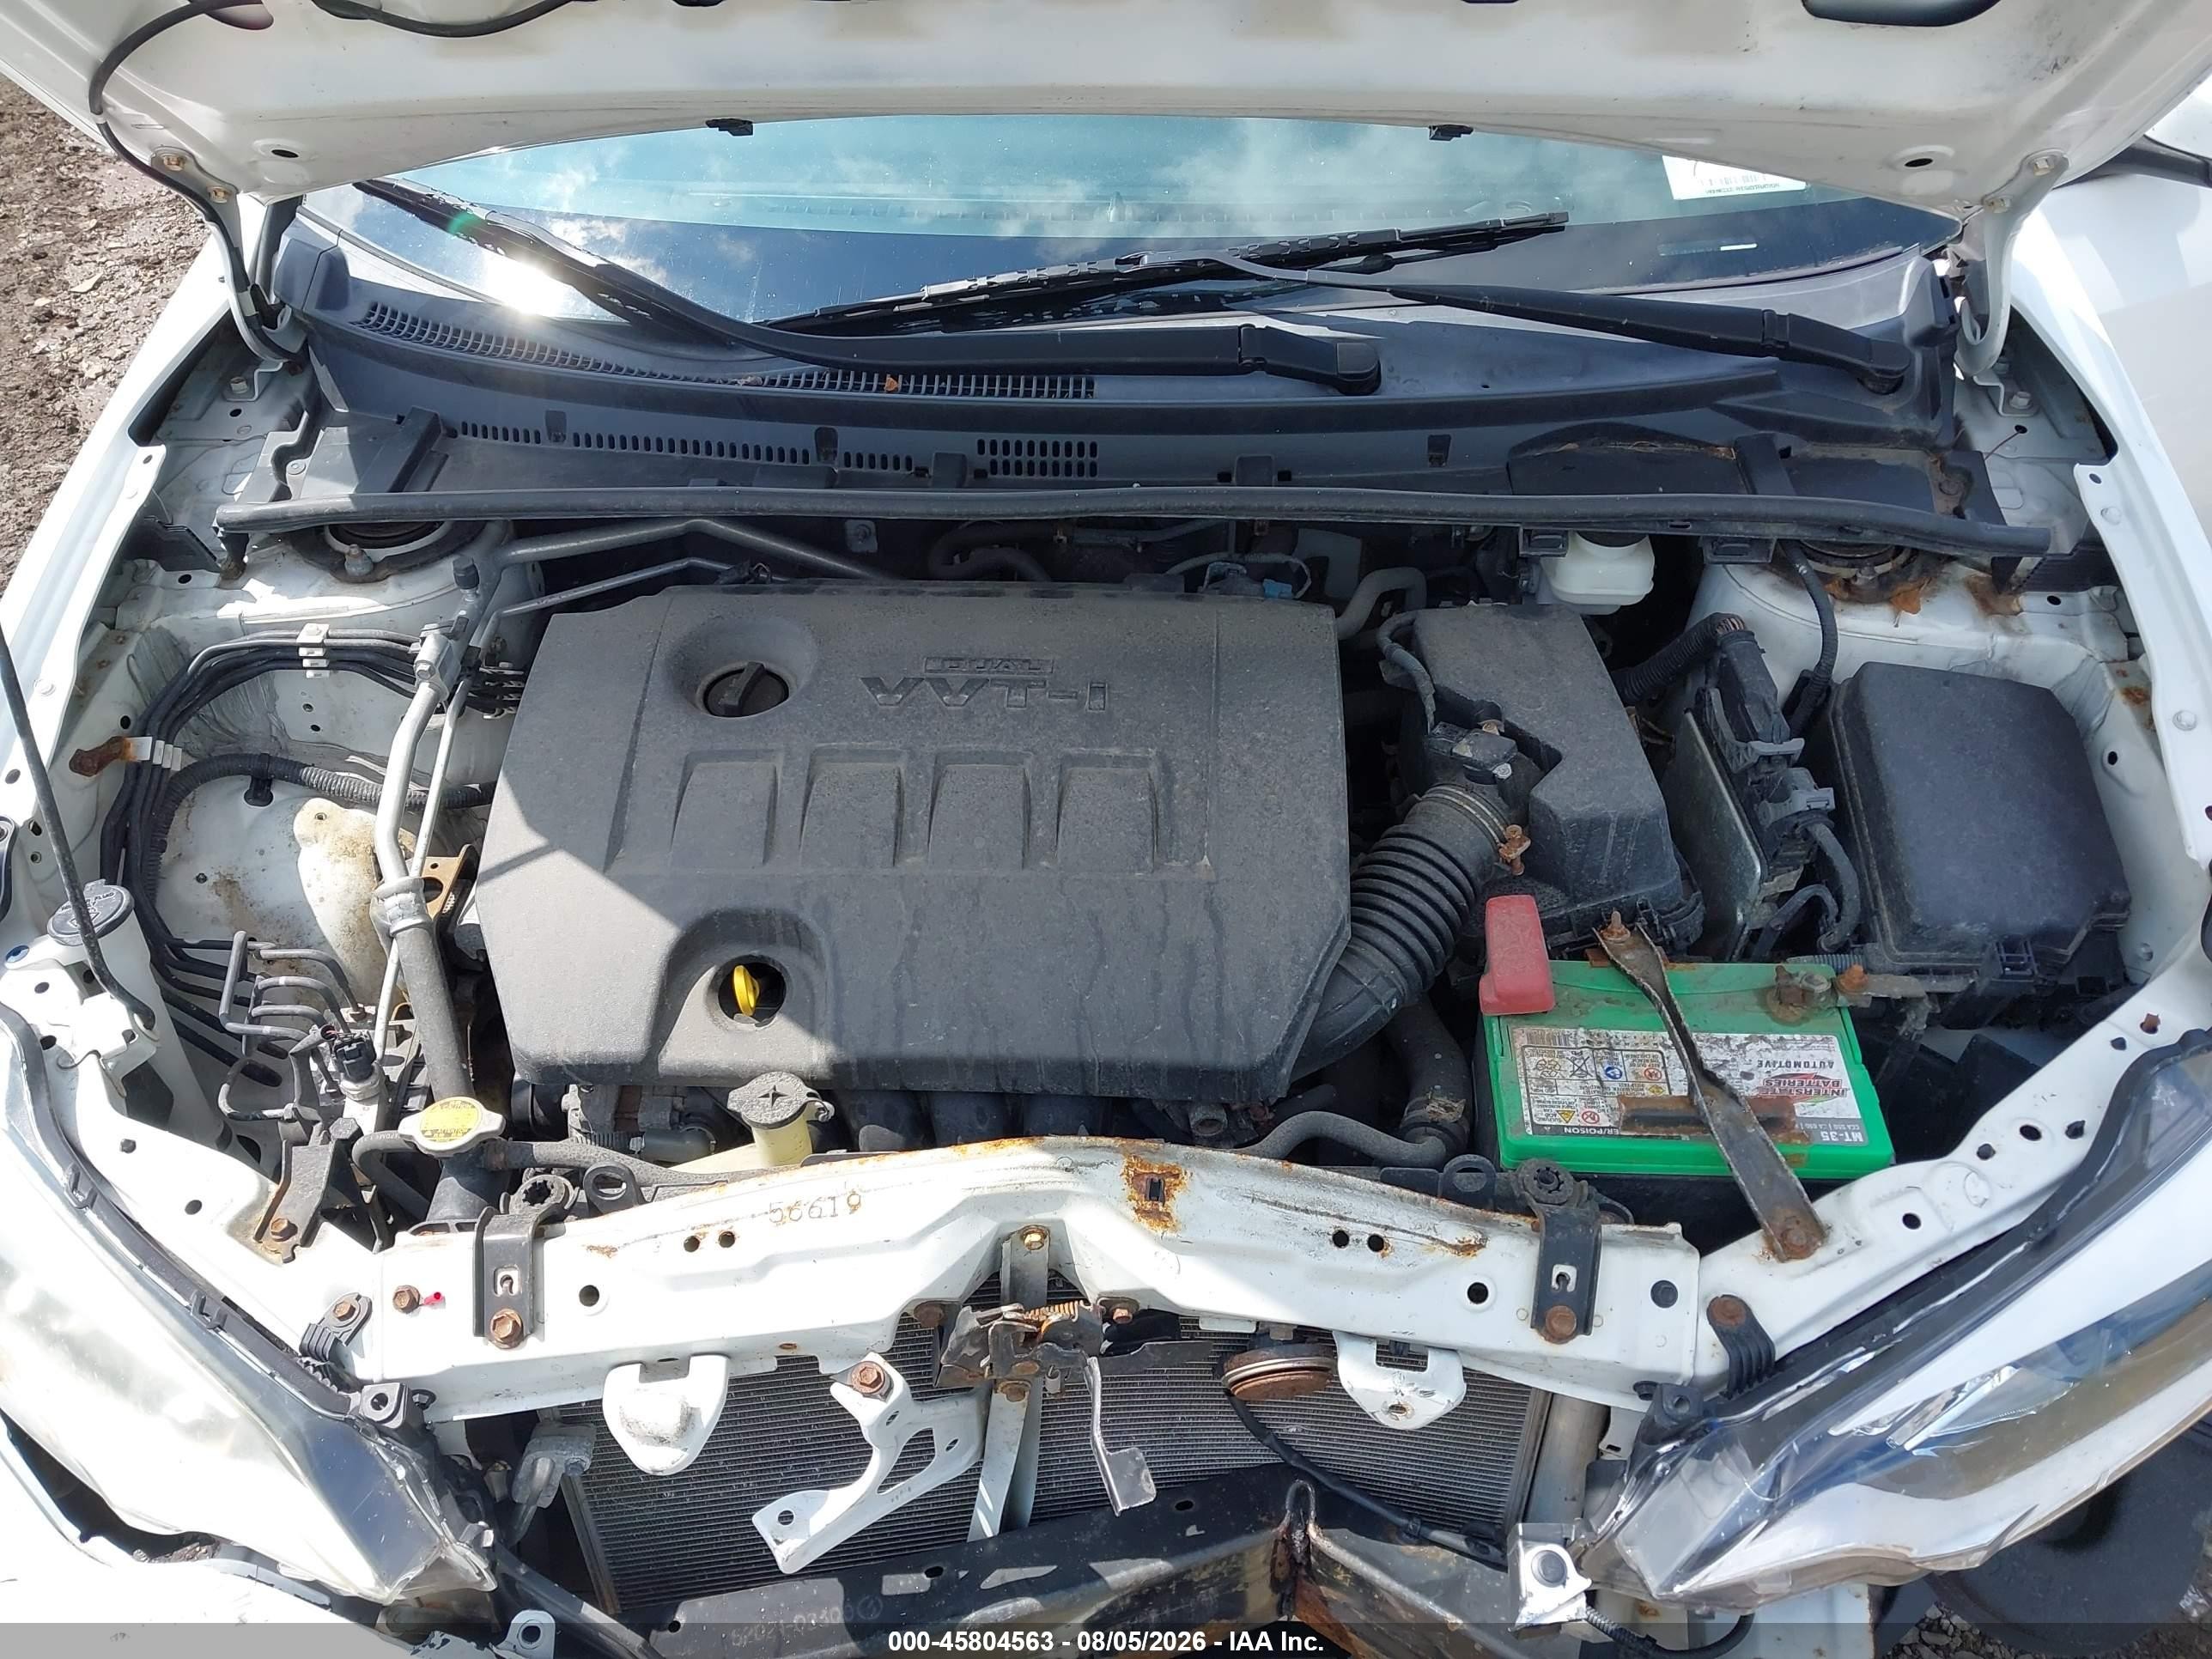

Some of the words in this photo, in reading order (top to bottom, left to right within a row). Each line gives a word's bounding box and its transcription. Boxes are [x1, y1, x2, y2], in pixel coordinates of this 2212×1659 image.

[1757, 1060, 1834, 1069] AUTOMOTIVE
[1762, 1079, 1842, 1089] BATTERIES
[1757, 1087, 1847, 1097] INTERSTATE
[1820, 1131, 1863, 1142] MT-35
